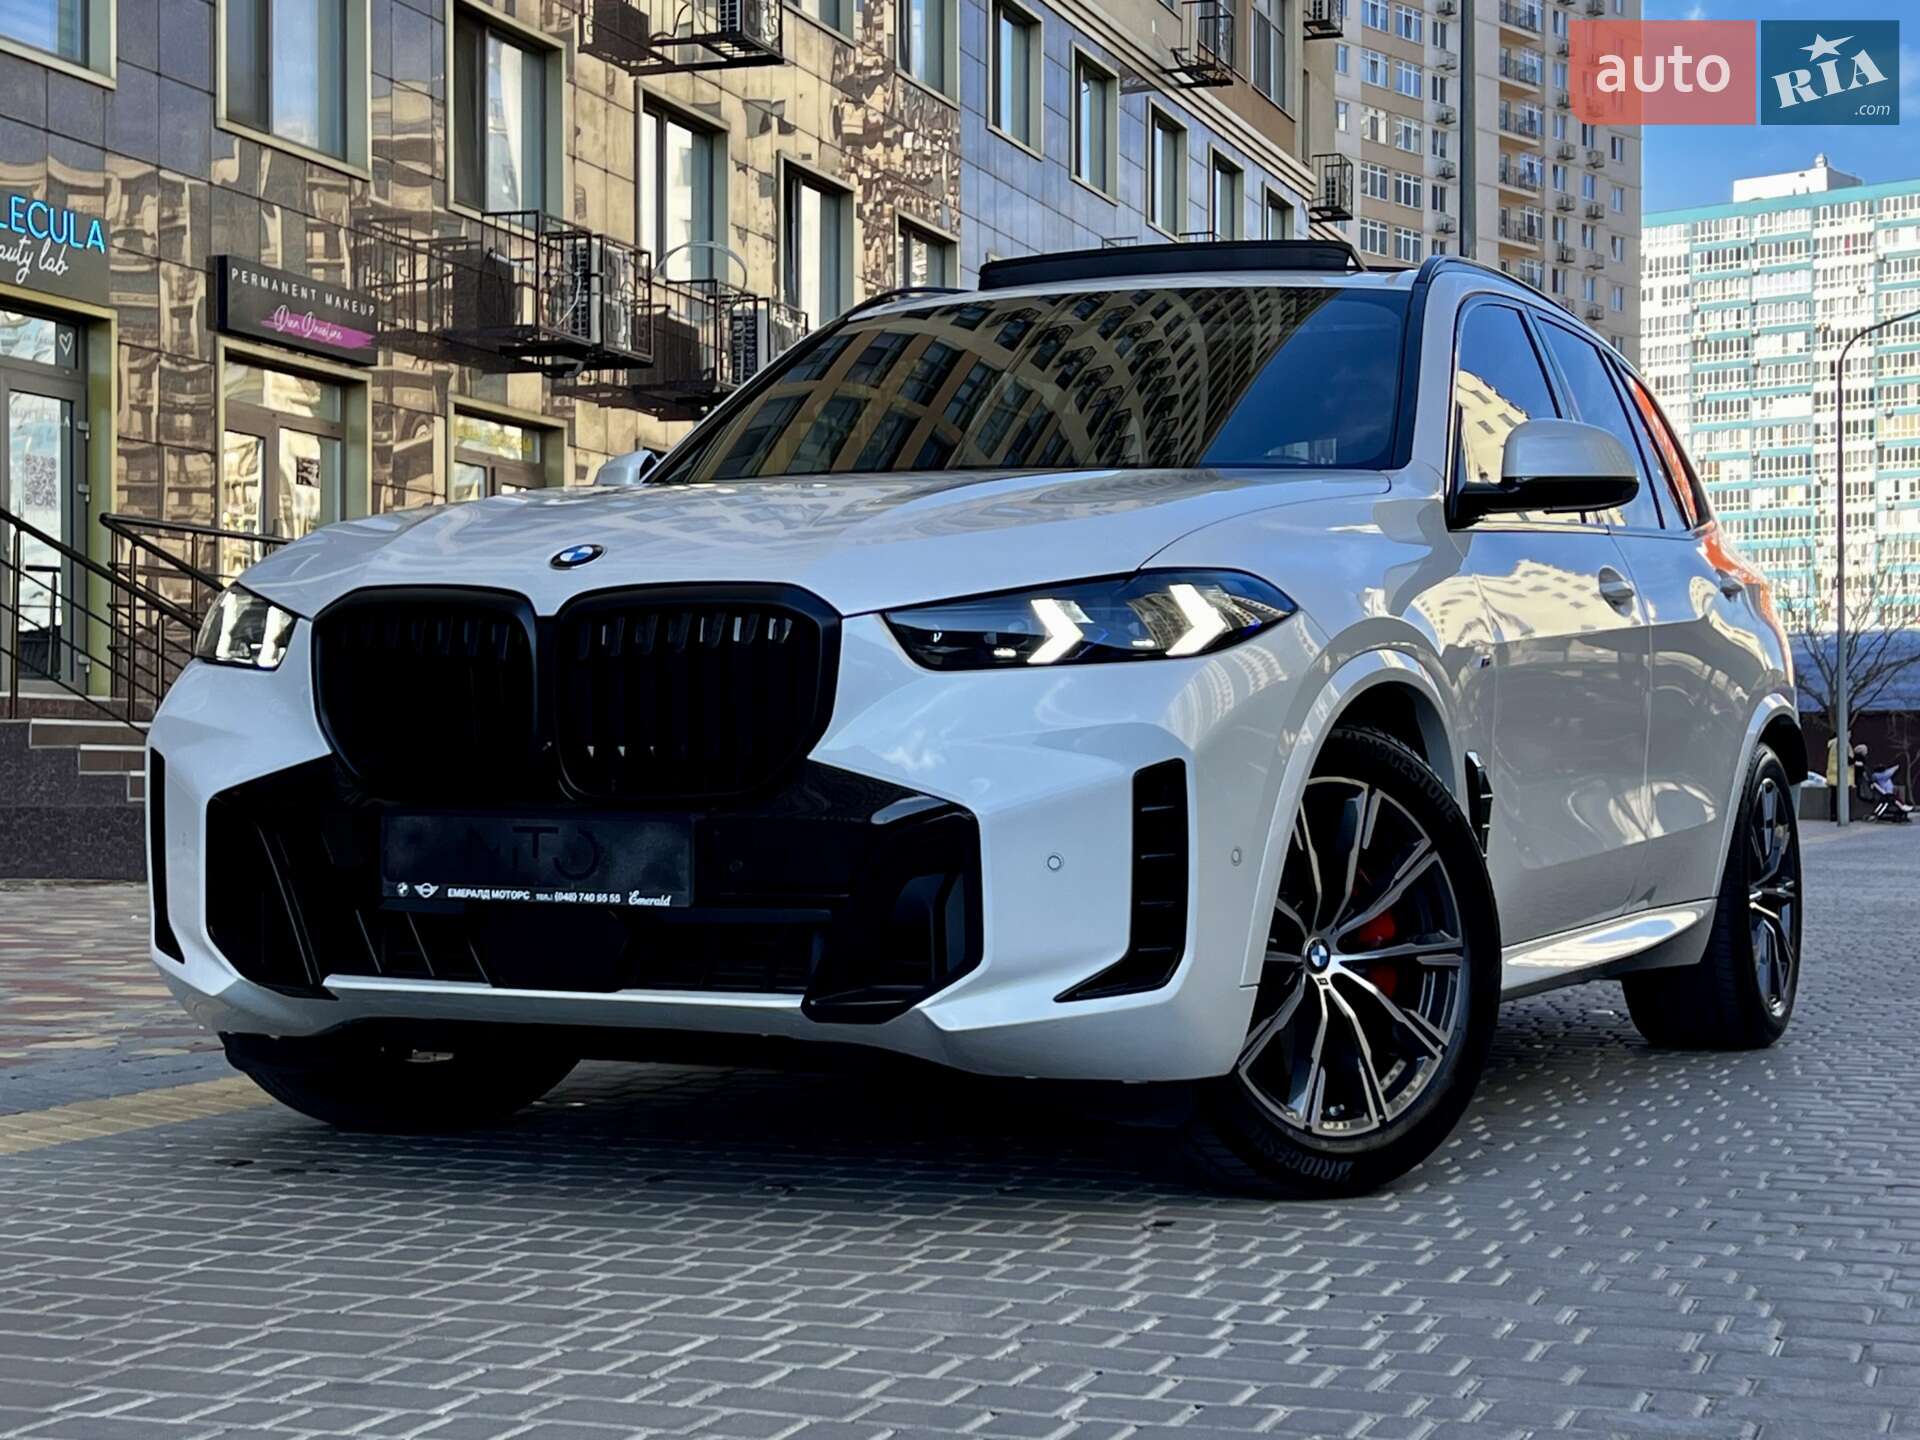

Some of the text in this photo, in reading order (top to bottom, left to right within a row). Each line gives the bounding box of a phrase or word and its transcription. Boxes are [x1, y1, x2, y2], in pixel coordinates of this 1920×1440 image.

[38, 237, 69, 276] lab
[231, 267, 376, 317] PERMANENT MAKEUP
[491, 889, 531, 901] МОТОРС
[578, 892, 596, 903] 740
[628, 889, 672, 907] Emerald
